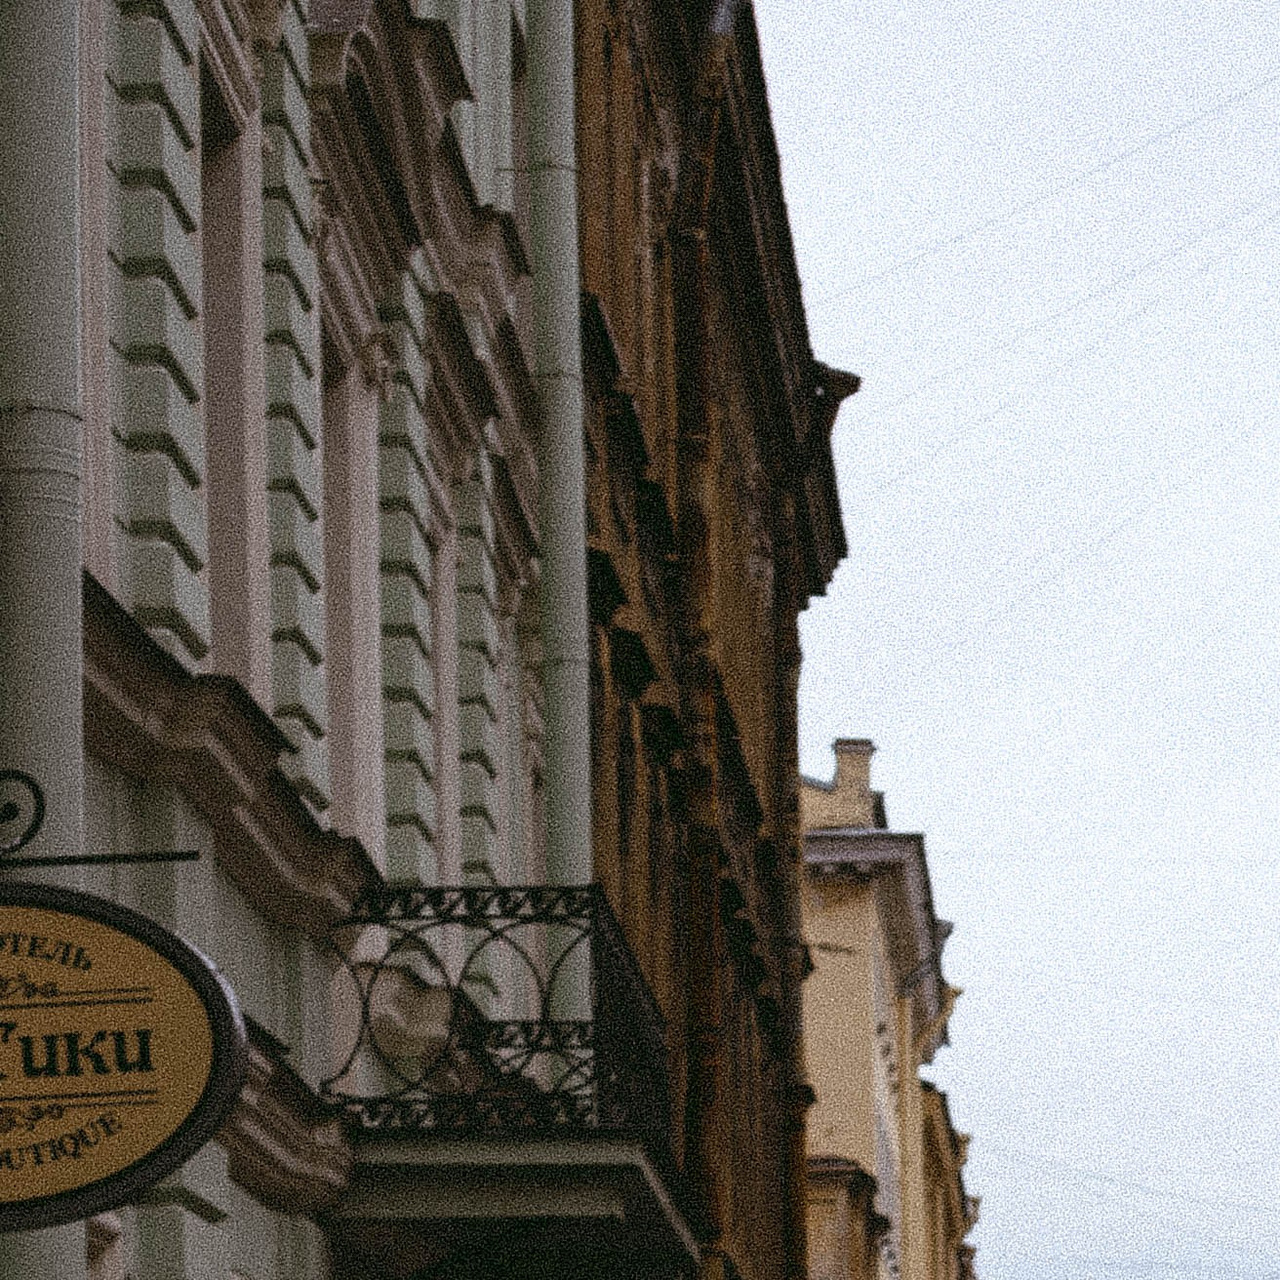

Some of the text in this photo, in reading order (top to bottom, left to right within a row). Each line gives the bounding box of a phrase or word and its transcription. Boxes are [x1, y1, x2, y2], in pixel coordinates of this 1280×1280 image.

[0, 932, 92, 970] ТЕЛЬ
[0, 1022, 154, 1079] ики
[0, 1110, 123, 1171] UTIQUE
